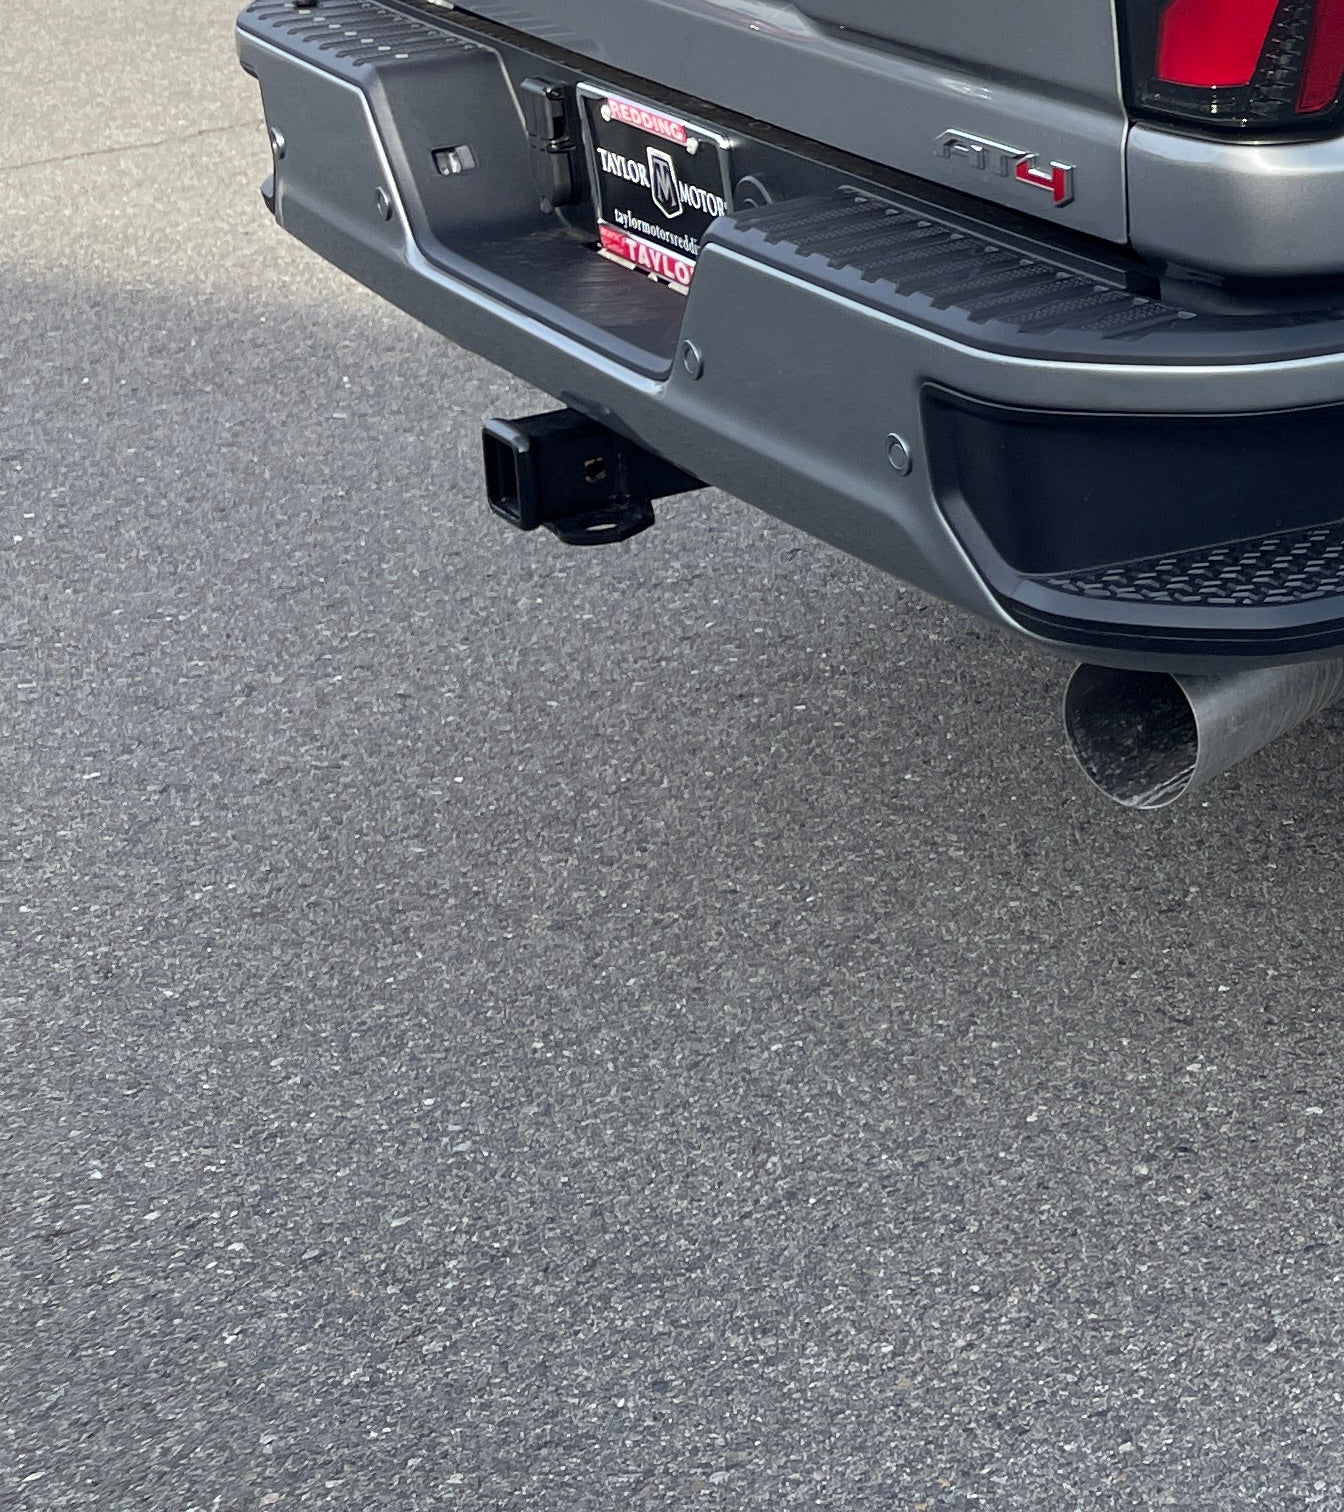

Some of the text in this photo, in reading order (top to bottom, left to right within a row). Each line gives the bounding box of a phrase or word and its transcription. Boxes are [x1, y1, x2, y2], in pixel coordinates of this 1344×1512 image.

[608, 101, 684, 140] REDDING
[597, 148, 650, 188] TAYLOR
[935, 128, 1076, 208] AT4
